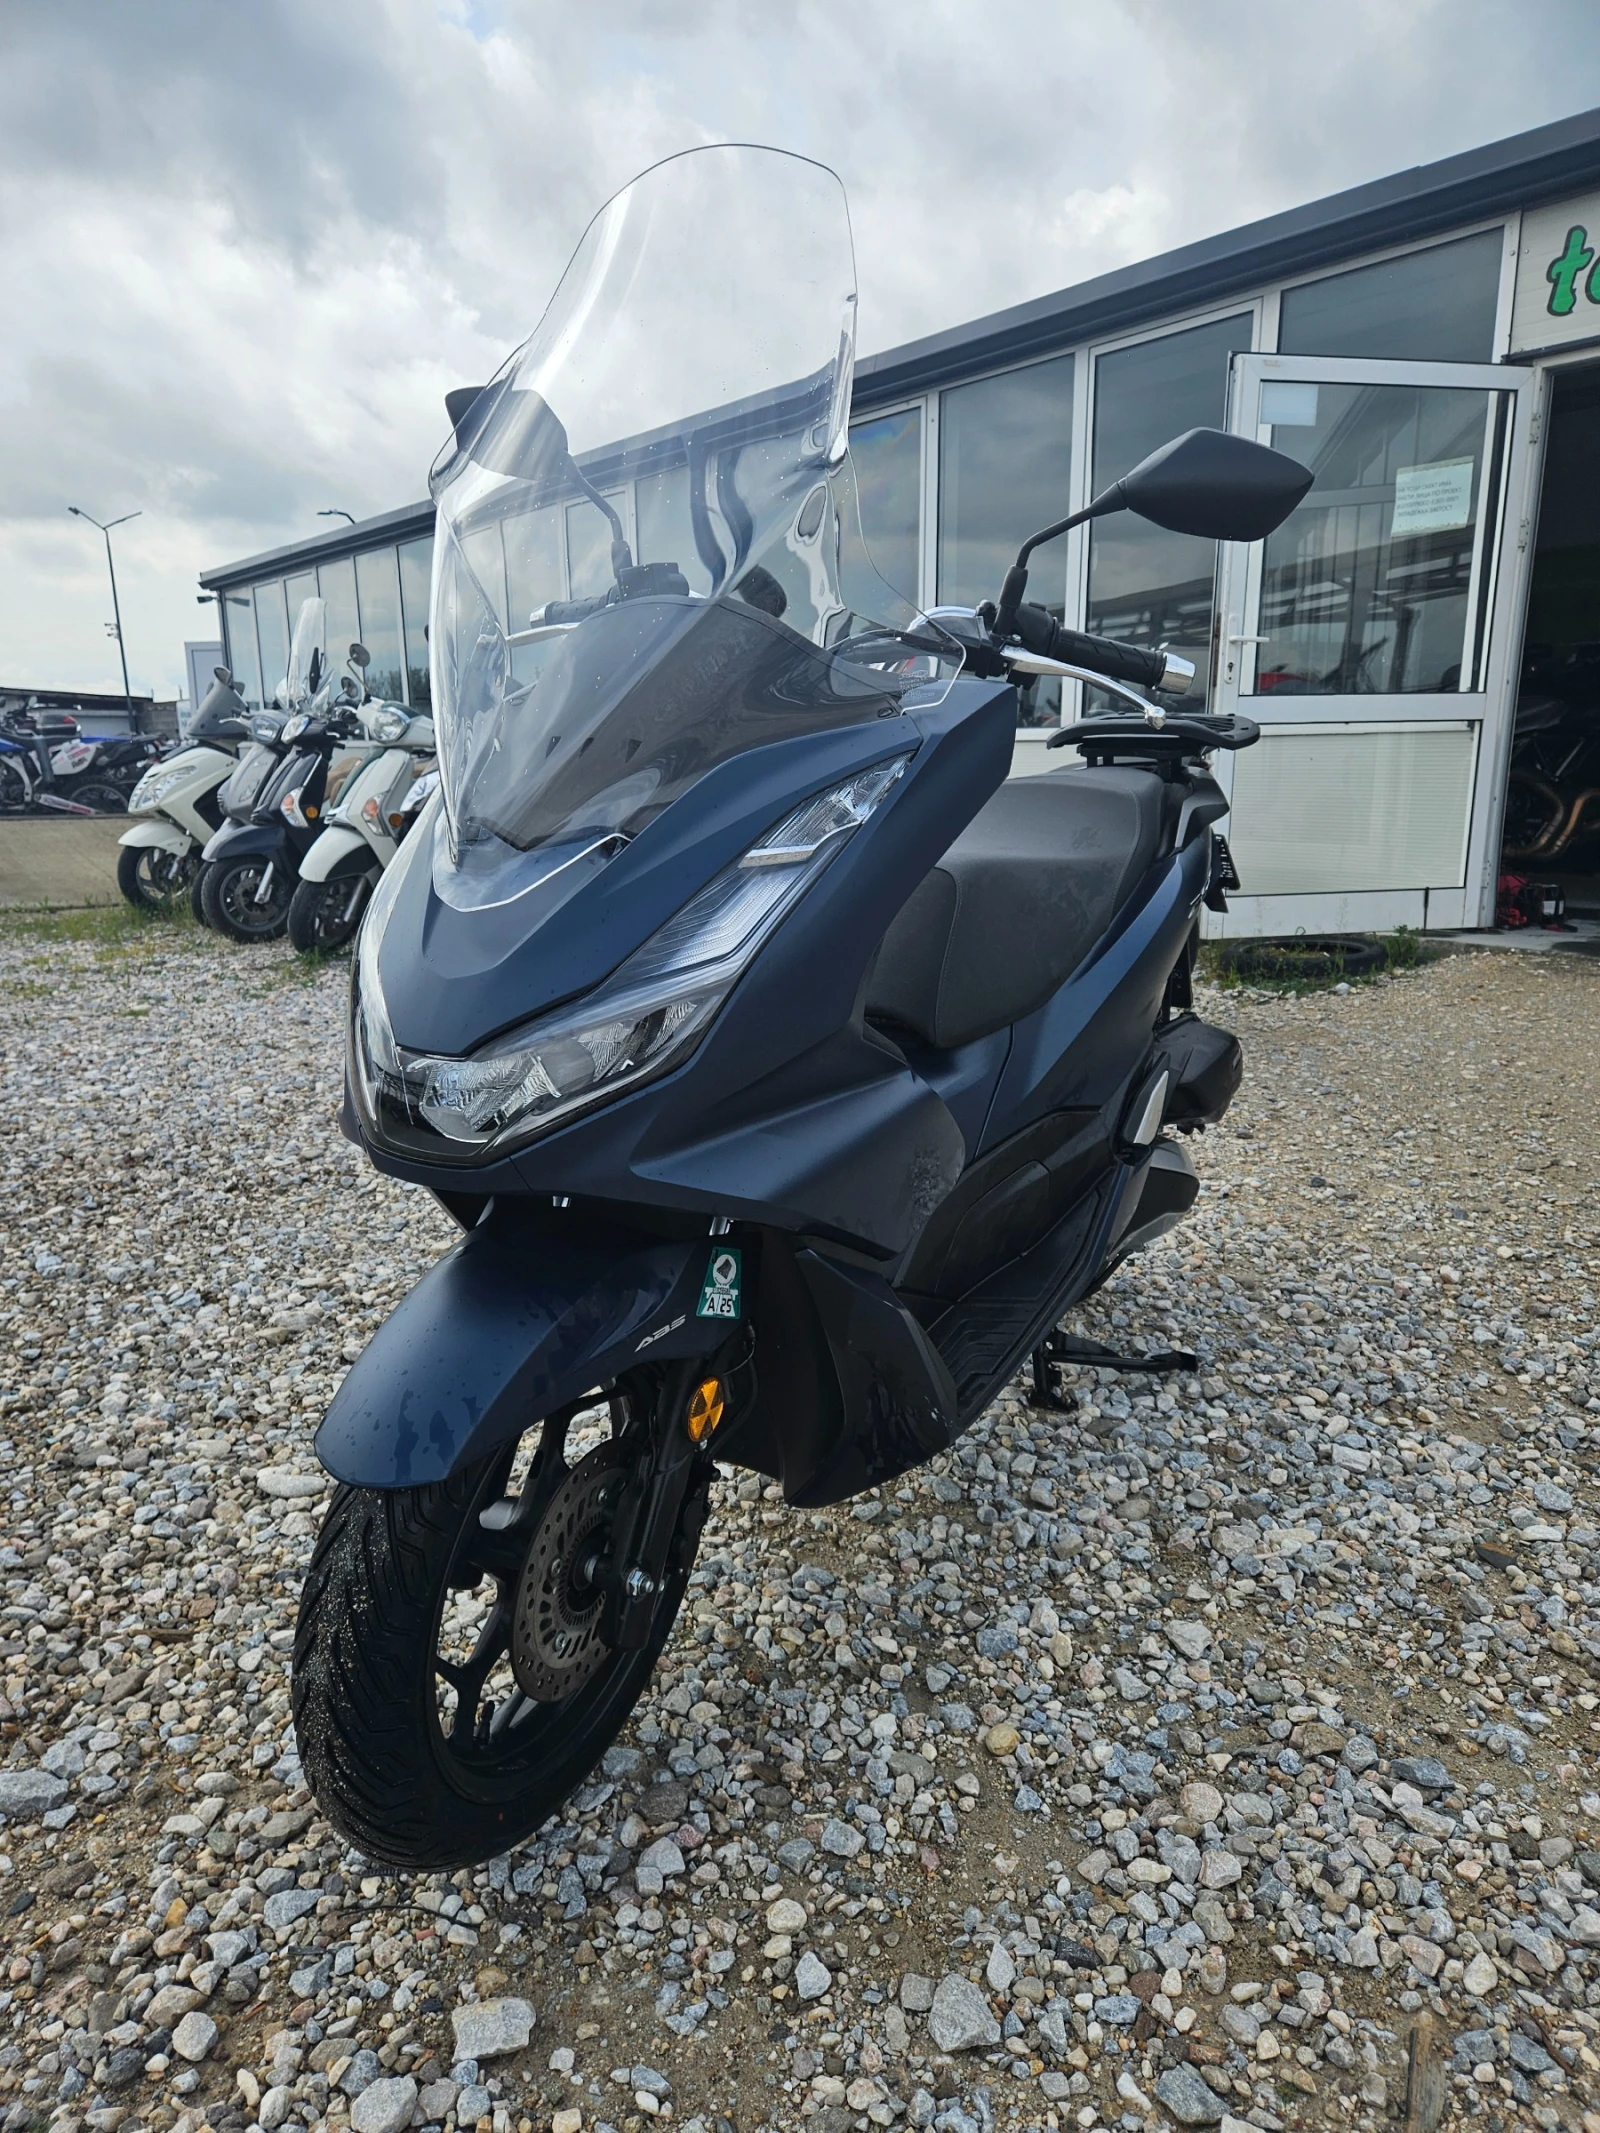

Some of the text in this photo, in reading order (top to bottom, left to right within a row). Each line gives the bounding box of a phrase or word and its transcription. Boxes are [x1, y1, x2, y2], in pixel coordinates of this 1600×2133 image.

[707, 1297, 732, 1313] A 25
[634, 1314, 686, 1352] ABS
